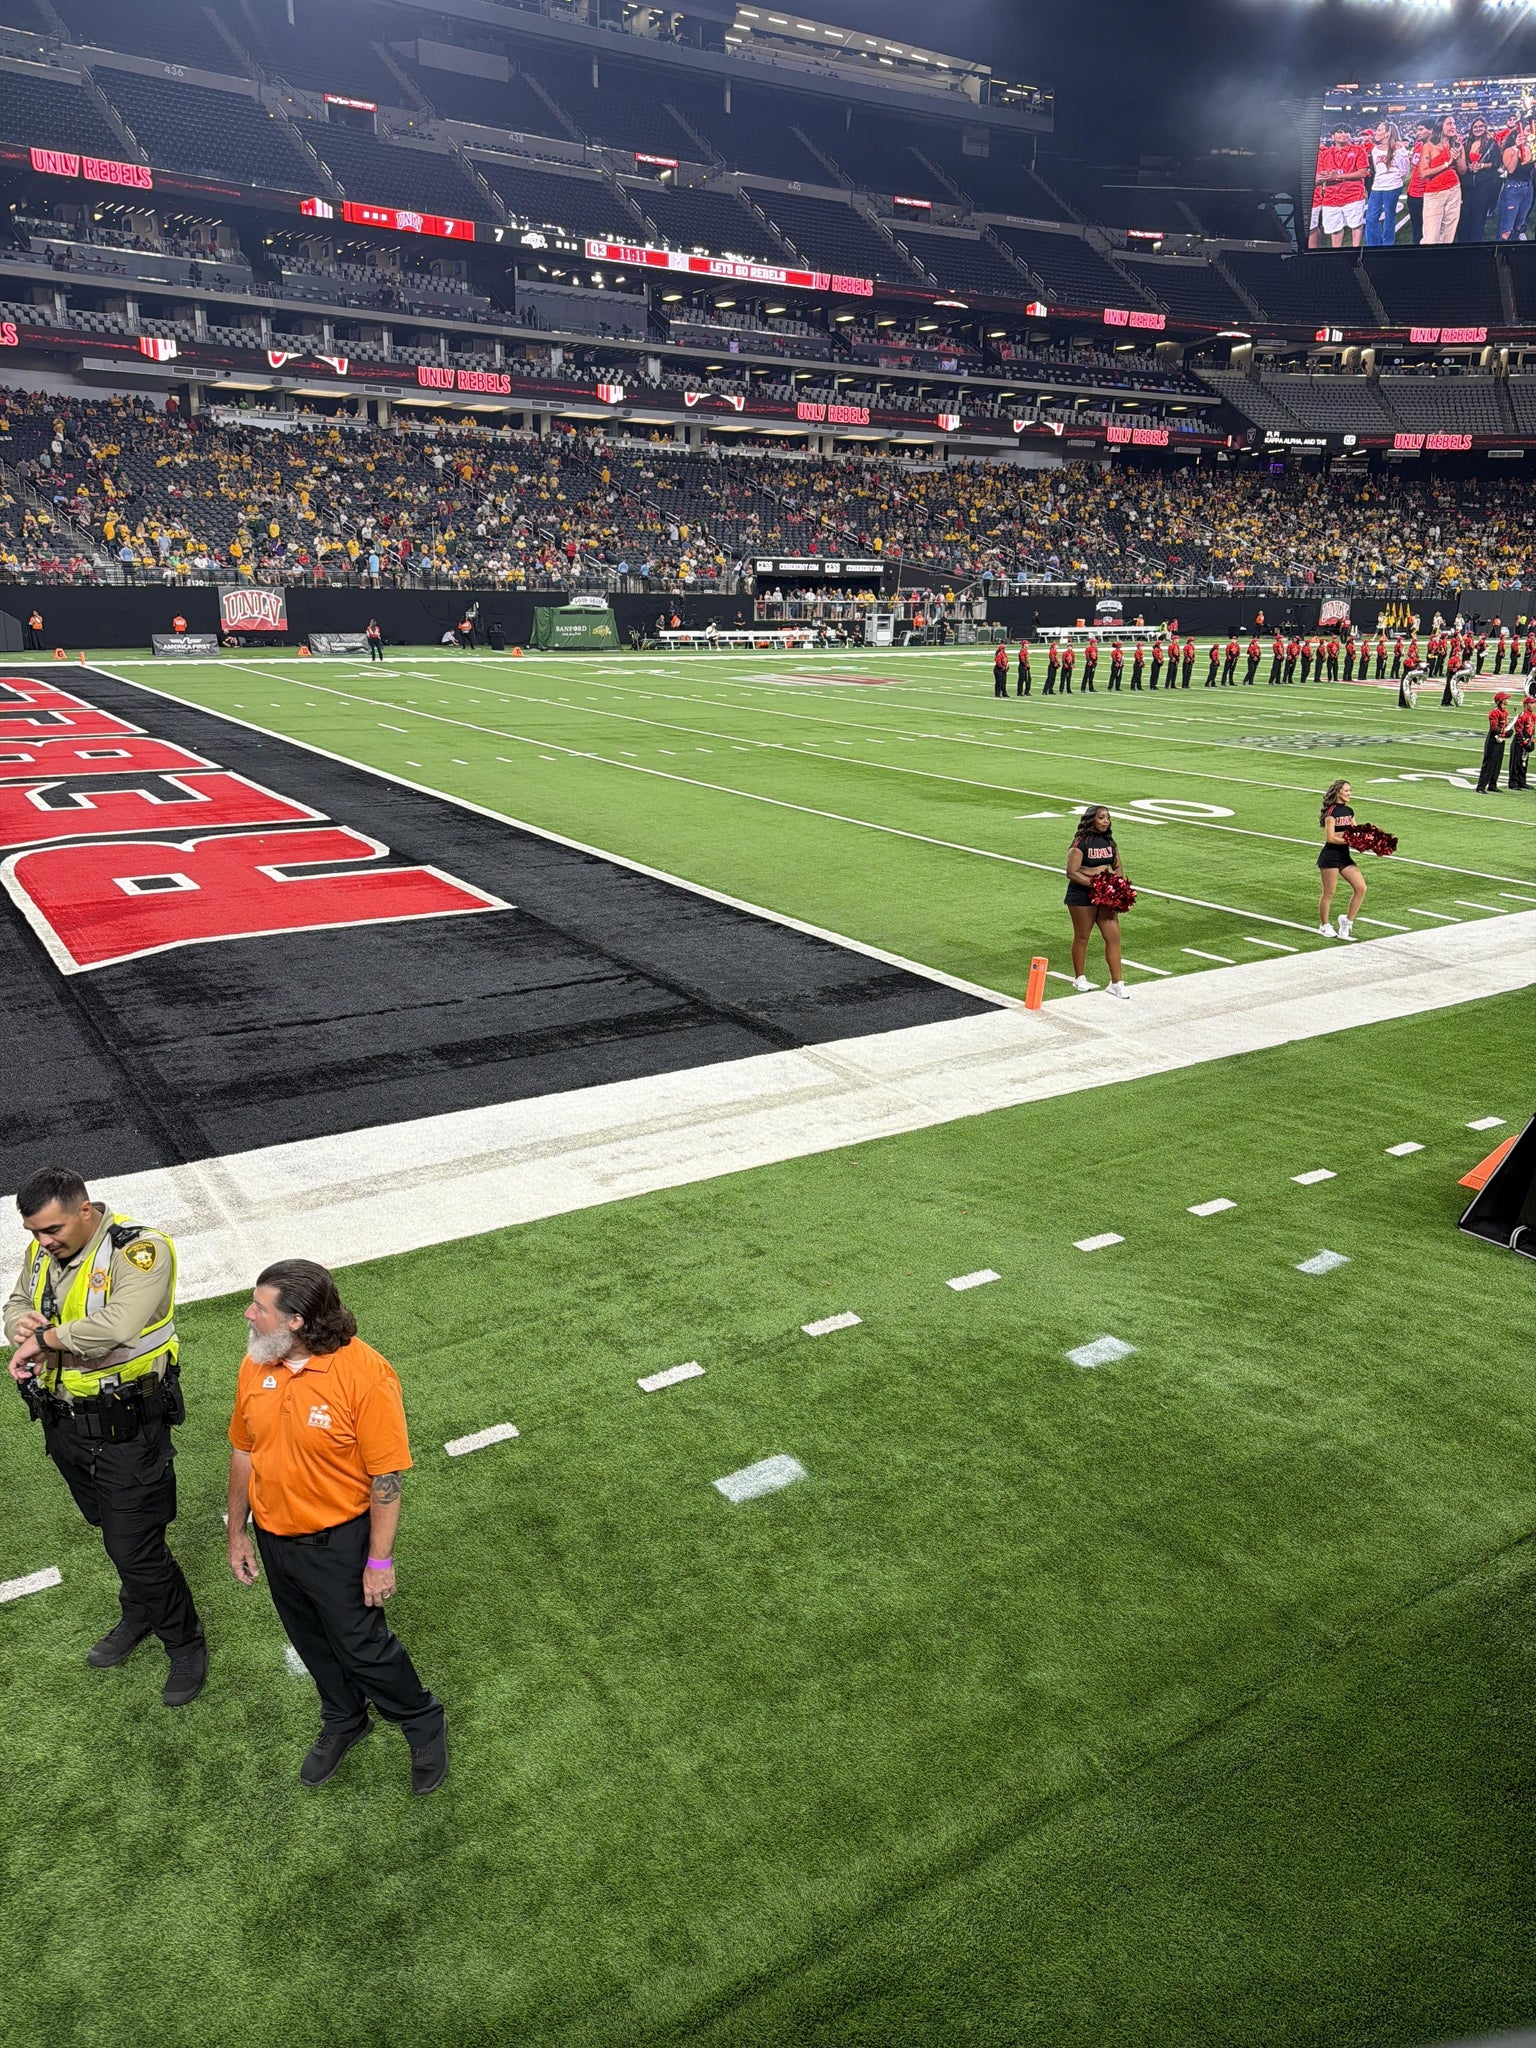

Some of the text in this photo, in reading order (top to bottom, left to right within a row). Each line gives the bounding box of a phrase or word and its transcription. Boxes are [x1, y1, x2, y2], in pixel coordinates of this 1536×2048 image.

[164, 65, 184, 77] 436
[30, 147, 153, 189] UNLV REBELS
[395, 211, 454, 234] UNLV 7
[494, 228, 504, 242] 7
[590, 242, 648, 263] Q3 11:11
[710, 261, 787, 283] LETS GO REBELS
[832, 275, 874, 297] REBELS
[1103, 308, 1166, 330] UNLV REBELS
[1410, 327, 1488, 343] UNLV REBELS
[418, 366, 512, 394] UNLV REBELS
[797, 402, 870, 424] UNLV REBELS
[1107, 426, 1169, 446] UNLV REBELS
[1394, 434, 1473, 450] UNLV REBELS
[191, 579, 204, 587] 130
[222, 589, 283, 627] UNLV
[1087, 846, 1113, 859] UNLV
